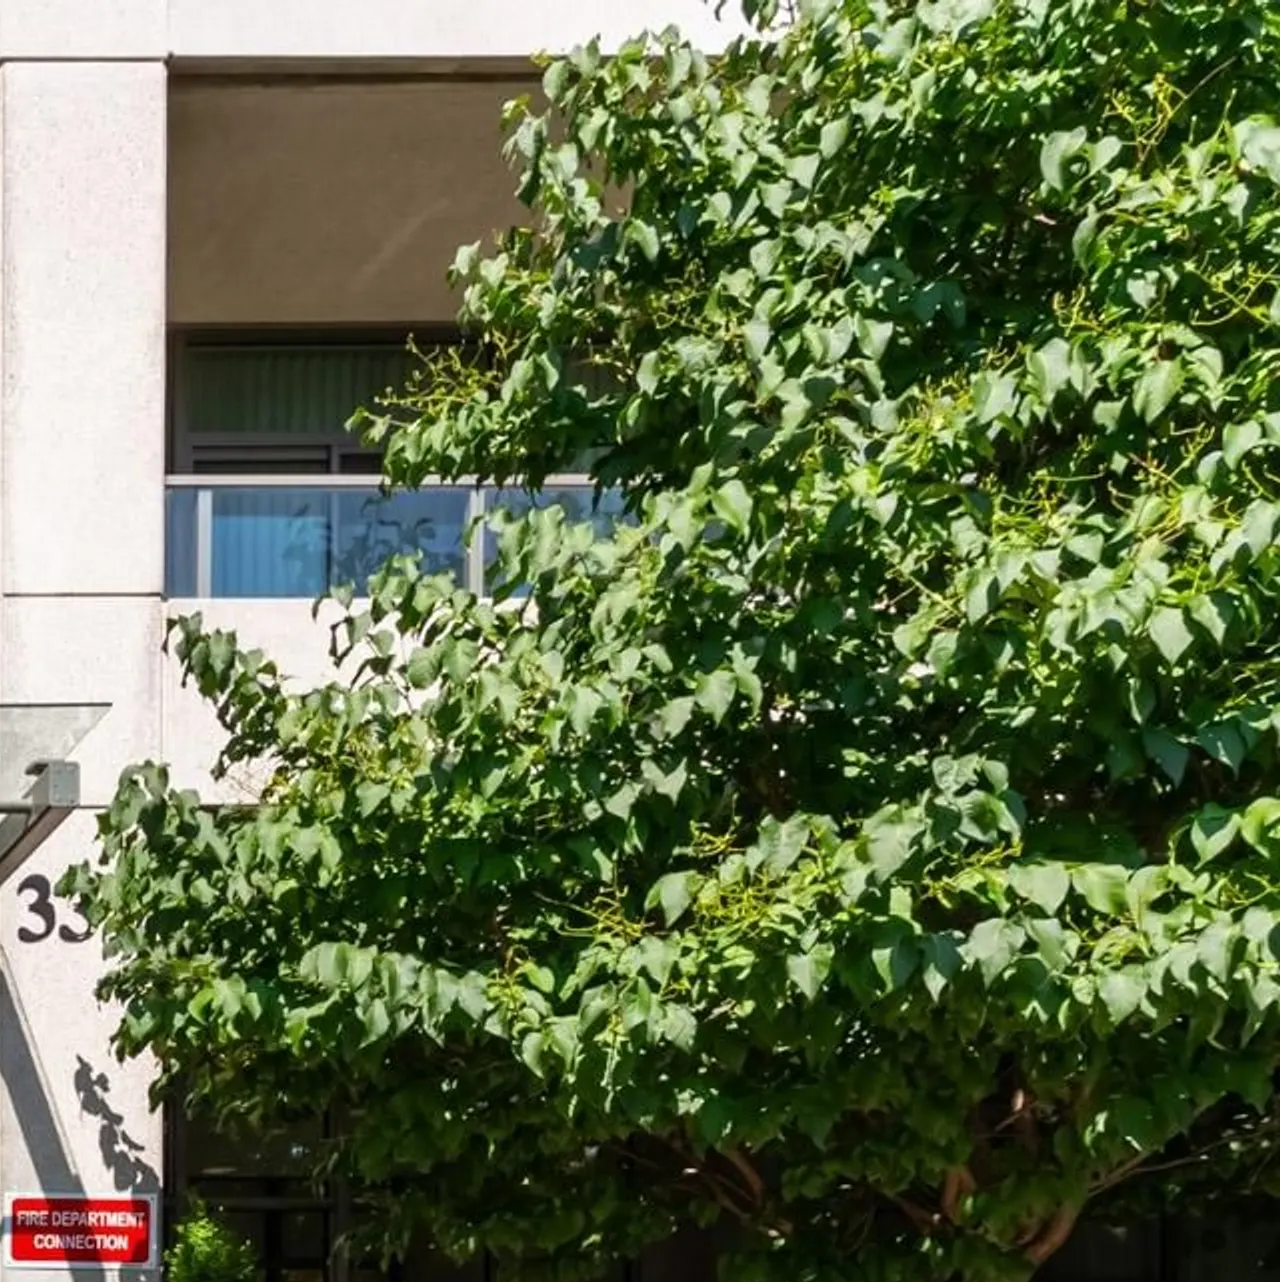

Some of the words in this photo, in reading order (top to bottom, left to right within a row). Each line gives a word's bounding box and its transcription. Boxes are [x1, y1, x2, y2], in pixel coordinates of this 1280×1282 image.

[16, 1210, 49, 1227] FIRE
[51, 1210, 145, 1228] DEPARTMENT
[33, 1233, 129, 1250] CONNECTION
